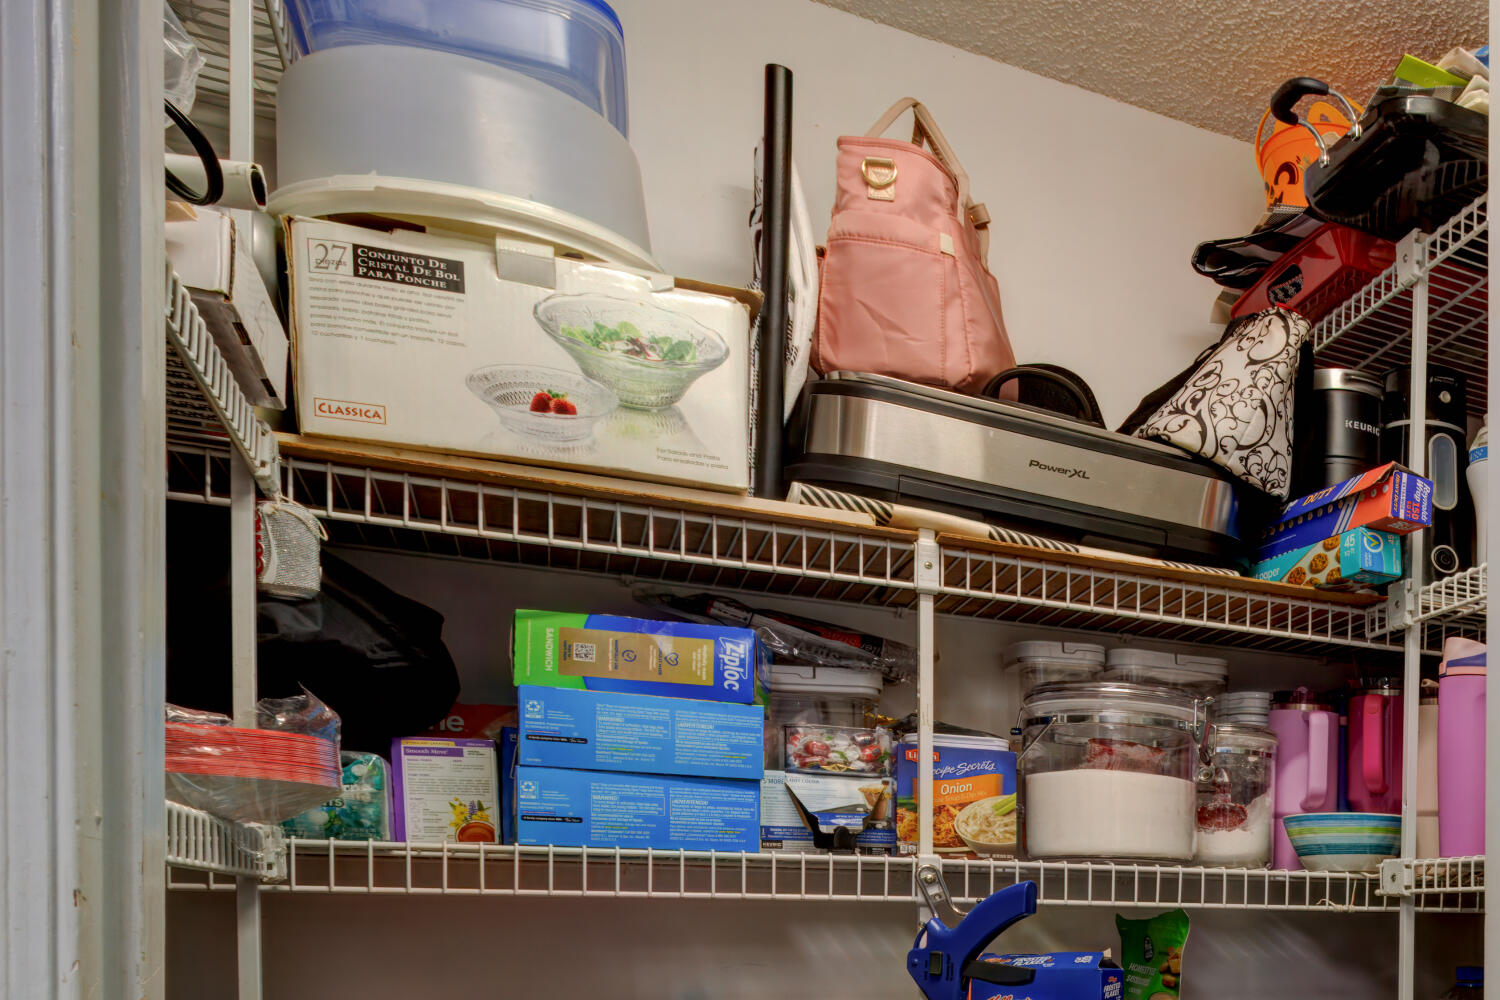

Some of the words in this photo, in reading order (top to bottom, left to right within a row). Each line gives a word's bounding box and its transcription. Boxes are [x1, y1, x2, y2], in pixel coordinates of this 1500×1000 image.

[314, 243, 347, 270] 27
[357, 247, 425, 266] CONJUNTO
[357, 257, 409, 273] CRISTAL
[435, 271, 461, 281] BOL
[357, 266, 393, 280] PARA
[396, 272, 448, 289] PONCHE
[318, 402, 383, 421] CLASSICA
[1028, 459, 1091, 480] PowerXL
[1414, 479, 1424, 503] Wrap
[1421, 481, 1431, 522] Reynolds
[1412, 501, 1420, 520] 150
[545, 627, 554, 671] SANDWICH
[719, 641, 745, 692] Ziploc
[907, 750, 938, 761] Lipn
[932, 766, 956, 778] ecipe
[956, 761, 997, 775] Secrets
[940, 781, 973, 795] Onion
[1103, 982, 1121, 993] FROSTED
